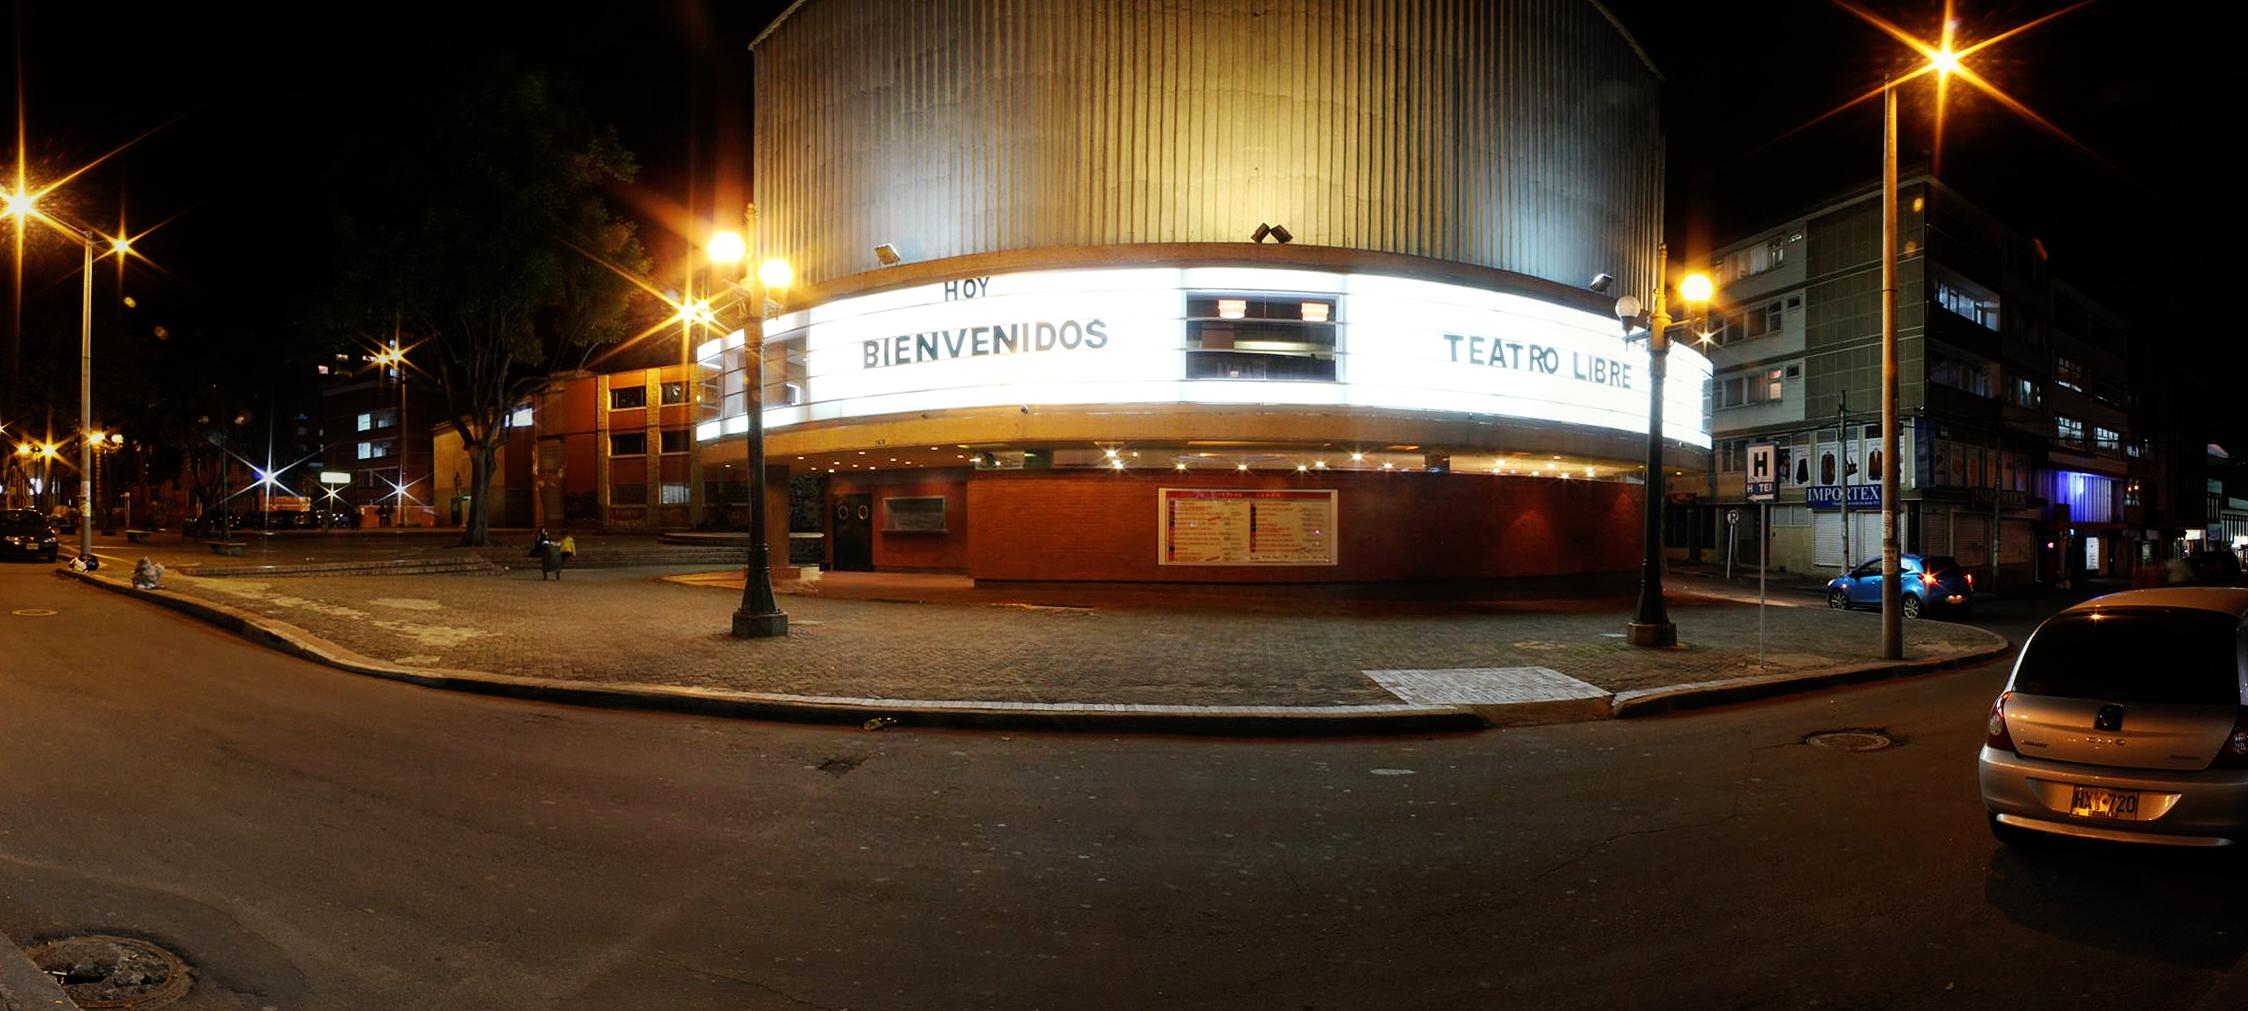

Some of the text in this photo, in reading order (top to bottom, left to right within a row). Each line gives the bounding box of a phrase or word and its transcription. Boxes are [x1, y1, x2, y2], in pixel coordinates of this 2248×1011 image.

[944, 277, 990, 302] HOY
[863, 319, 1108, 369] BIENVENIDOS
[1443, 334, 1632, 389] TEATRO LIBRE
[1754, 451, 1767, 476] H
[1747, 483, 1772, 493] HTEL
[2107, 793, 2136, 812] 720
